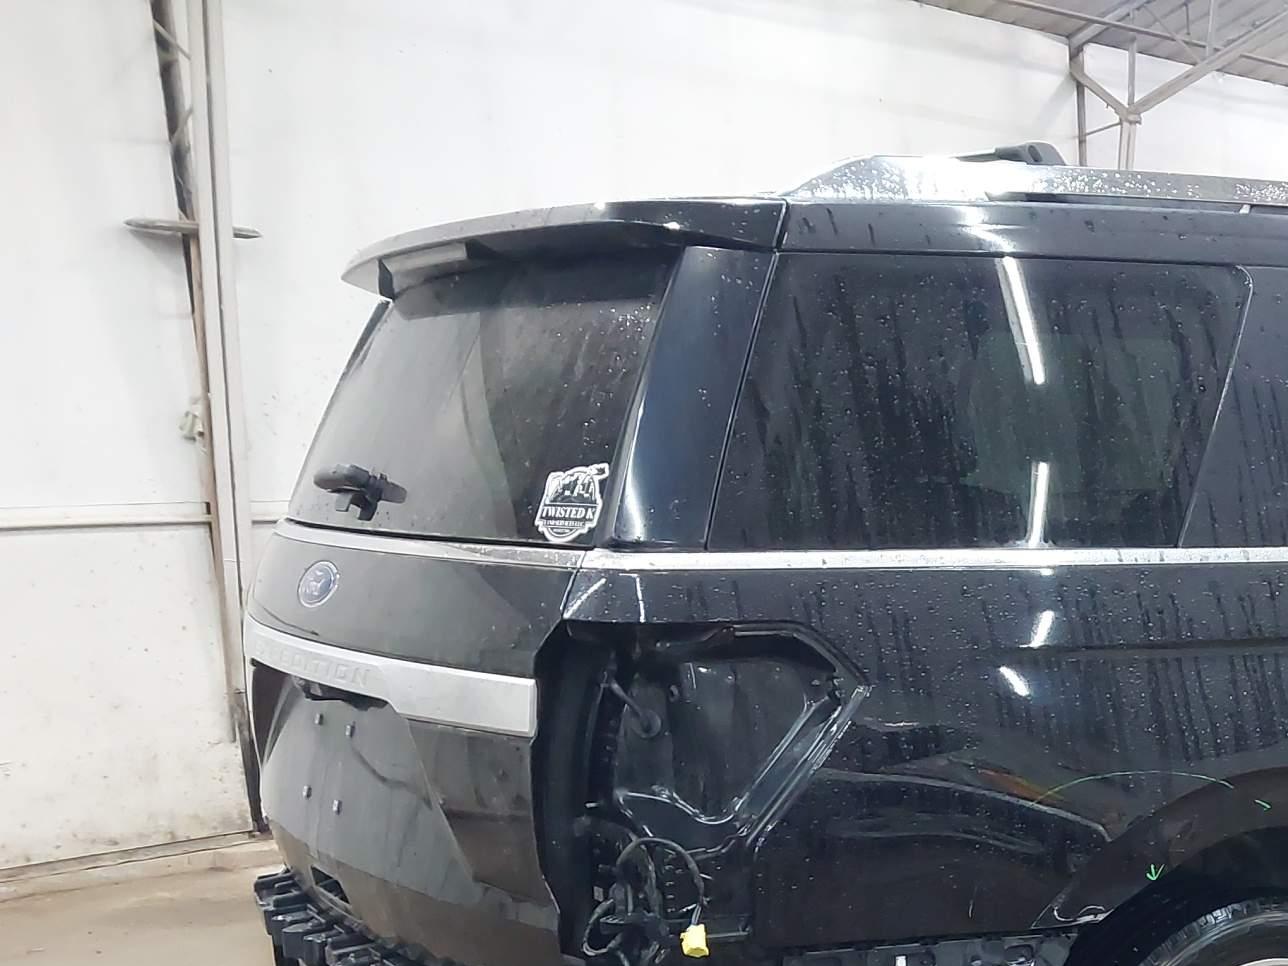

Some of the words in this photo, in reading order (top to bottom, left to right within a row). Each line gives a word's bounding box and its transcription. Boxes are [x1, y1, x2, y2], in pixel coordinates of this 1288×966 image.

[542, 505, 586, 519] TWISTED
[585, 507, 597, 520] K
[255, 640, 372, 688] EDITION
